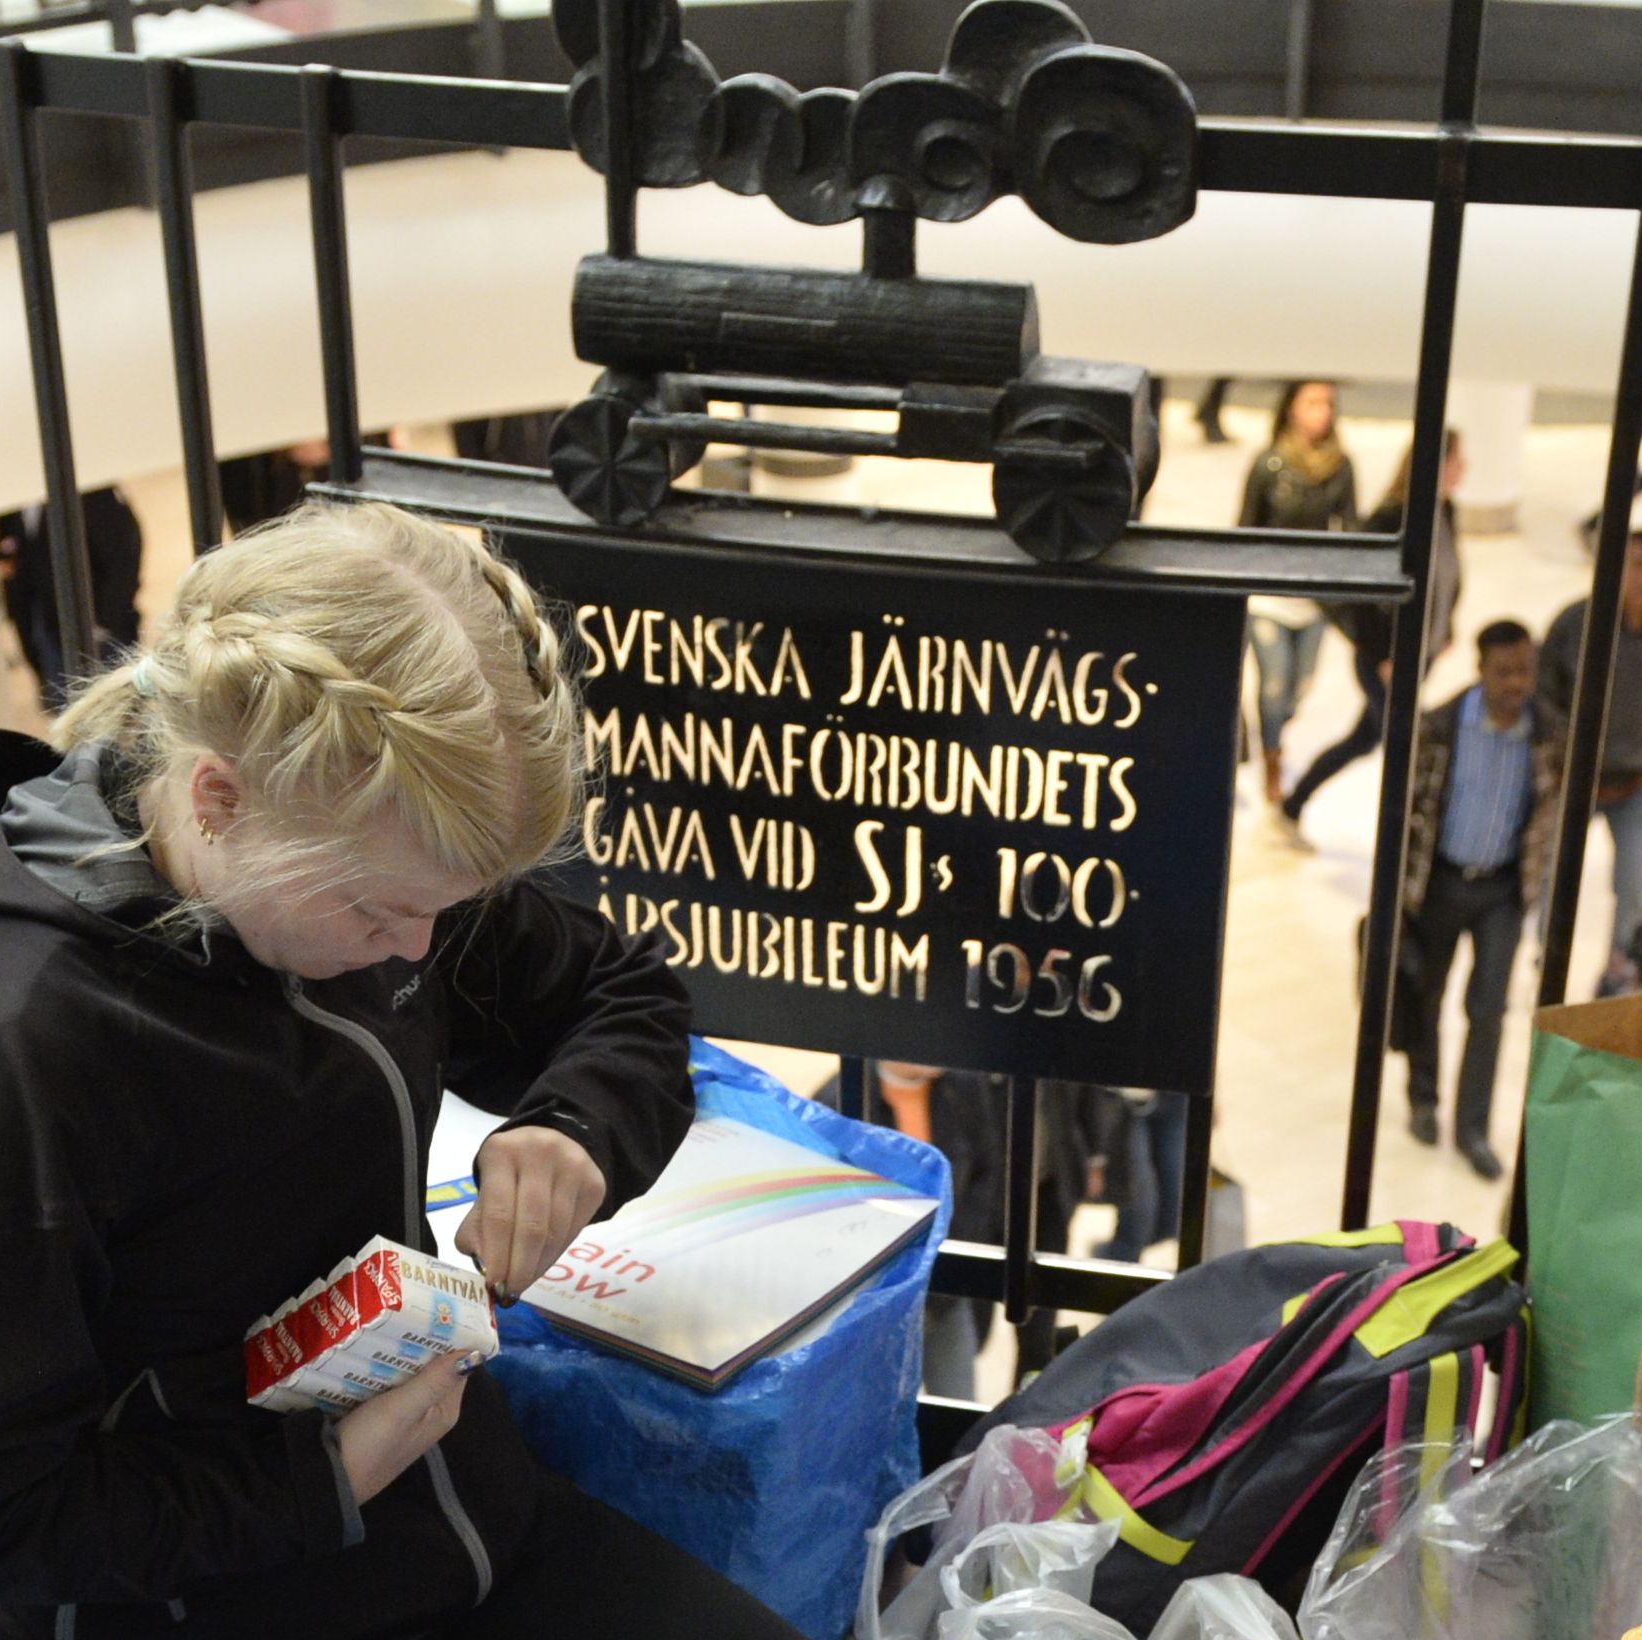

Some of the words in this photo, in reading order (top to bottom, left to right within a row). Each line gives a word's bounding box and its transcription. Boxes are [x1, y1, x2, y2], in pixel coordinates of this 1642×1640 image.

[576, 604, 812, 699] SVENSKA
[585, 706, 1139, 832] MANNAFÖRBUNDETS
[584, 786, 716, 881] GÅVA
[730, 814, 816, 891] VID
[961, 939, 1123, 1023] 1956
[541, 1263, 628, 1300] ow
[567, 1240, 656, 1283] ain
